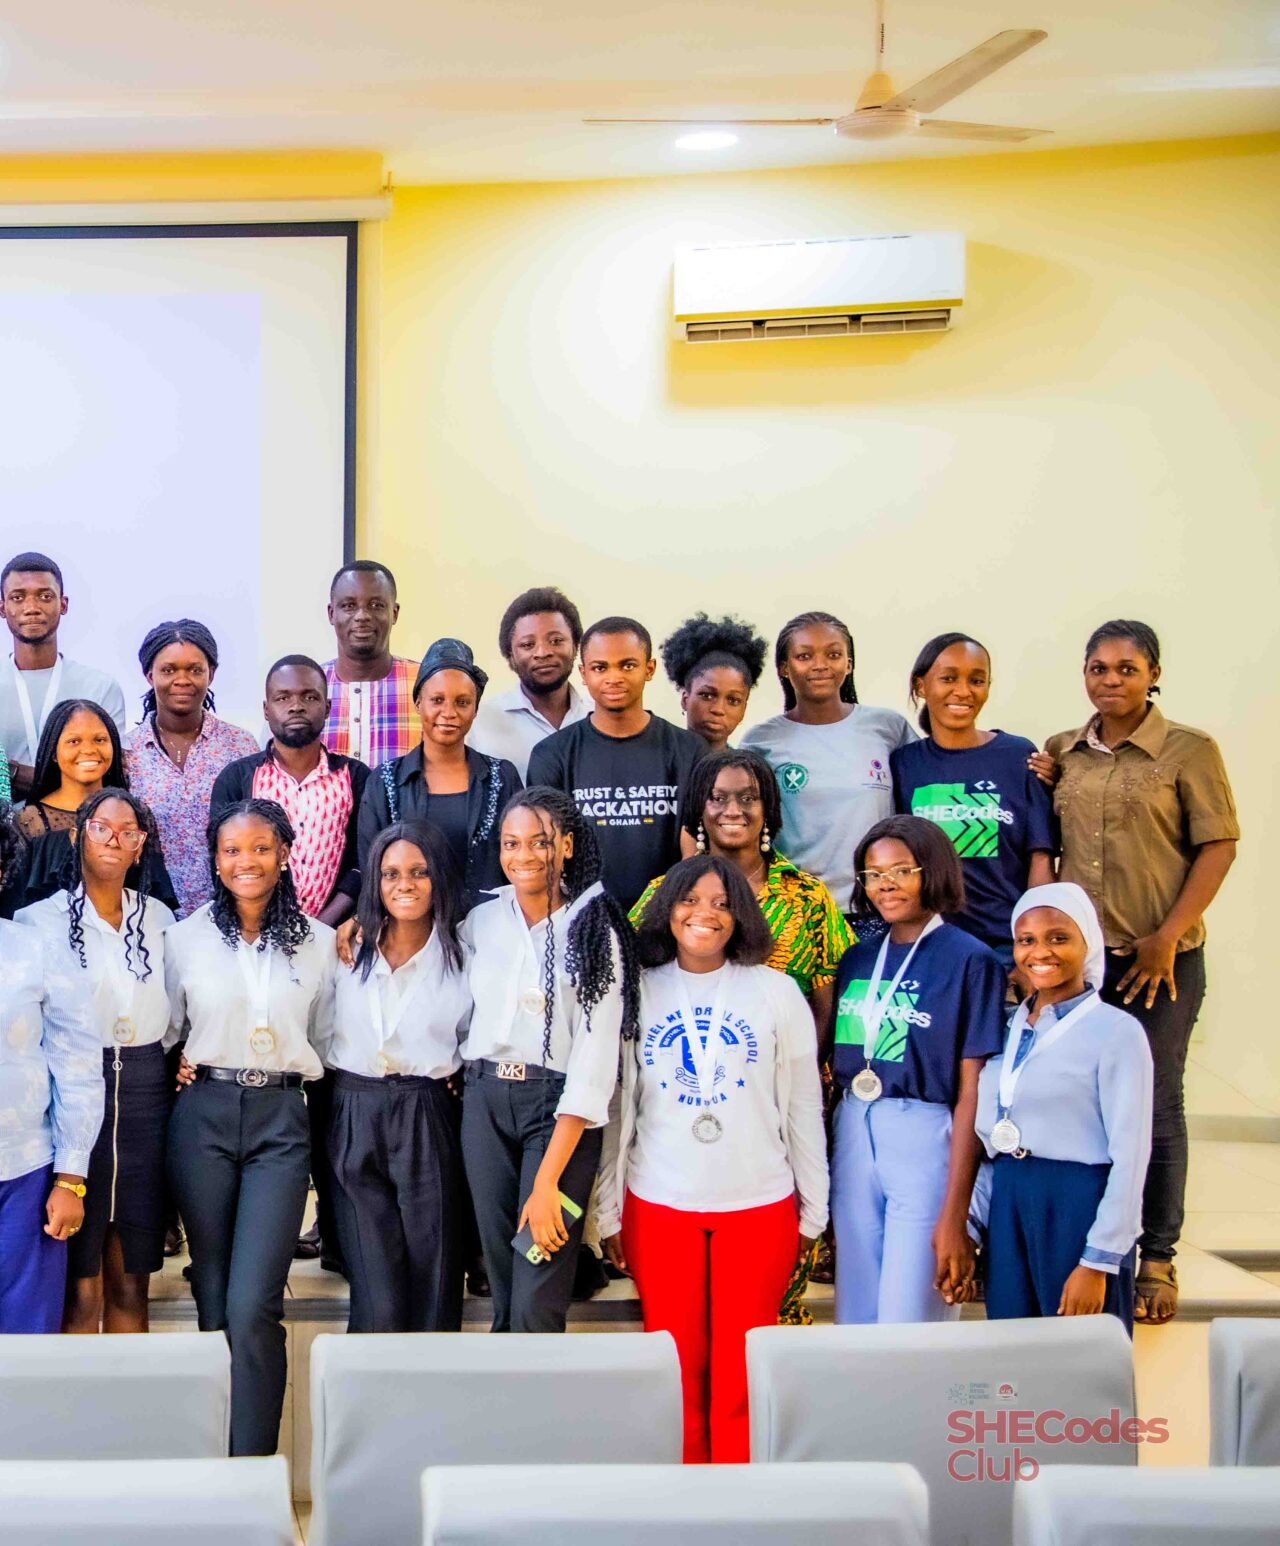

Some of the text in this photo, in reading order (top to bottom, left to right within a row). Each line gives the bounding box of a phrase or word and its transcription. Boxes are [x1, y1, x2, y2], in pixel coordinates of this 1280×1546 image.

[572, 785, 678, 800] RUST & SAFETY
[576, 800, 678, 816] ACKATHON
[913, 803, 1014, 825] SHECodes
[609, 818, 641, 826] GHANA
[644, 1024, 666, 1066] BETHEL
[734, 1018, 758, 1064] SCHOOL
